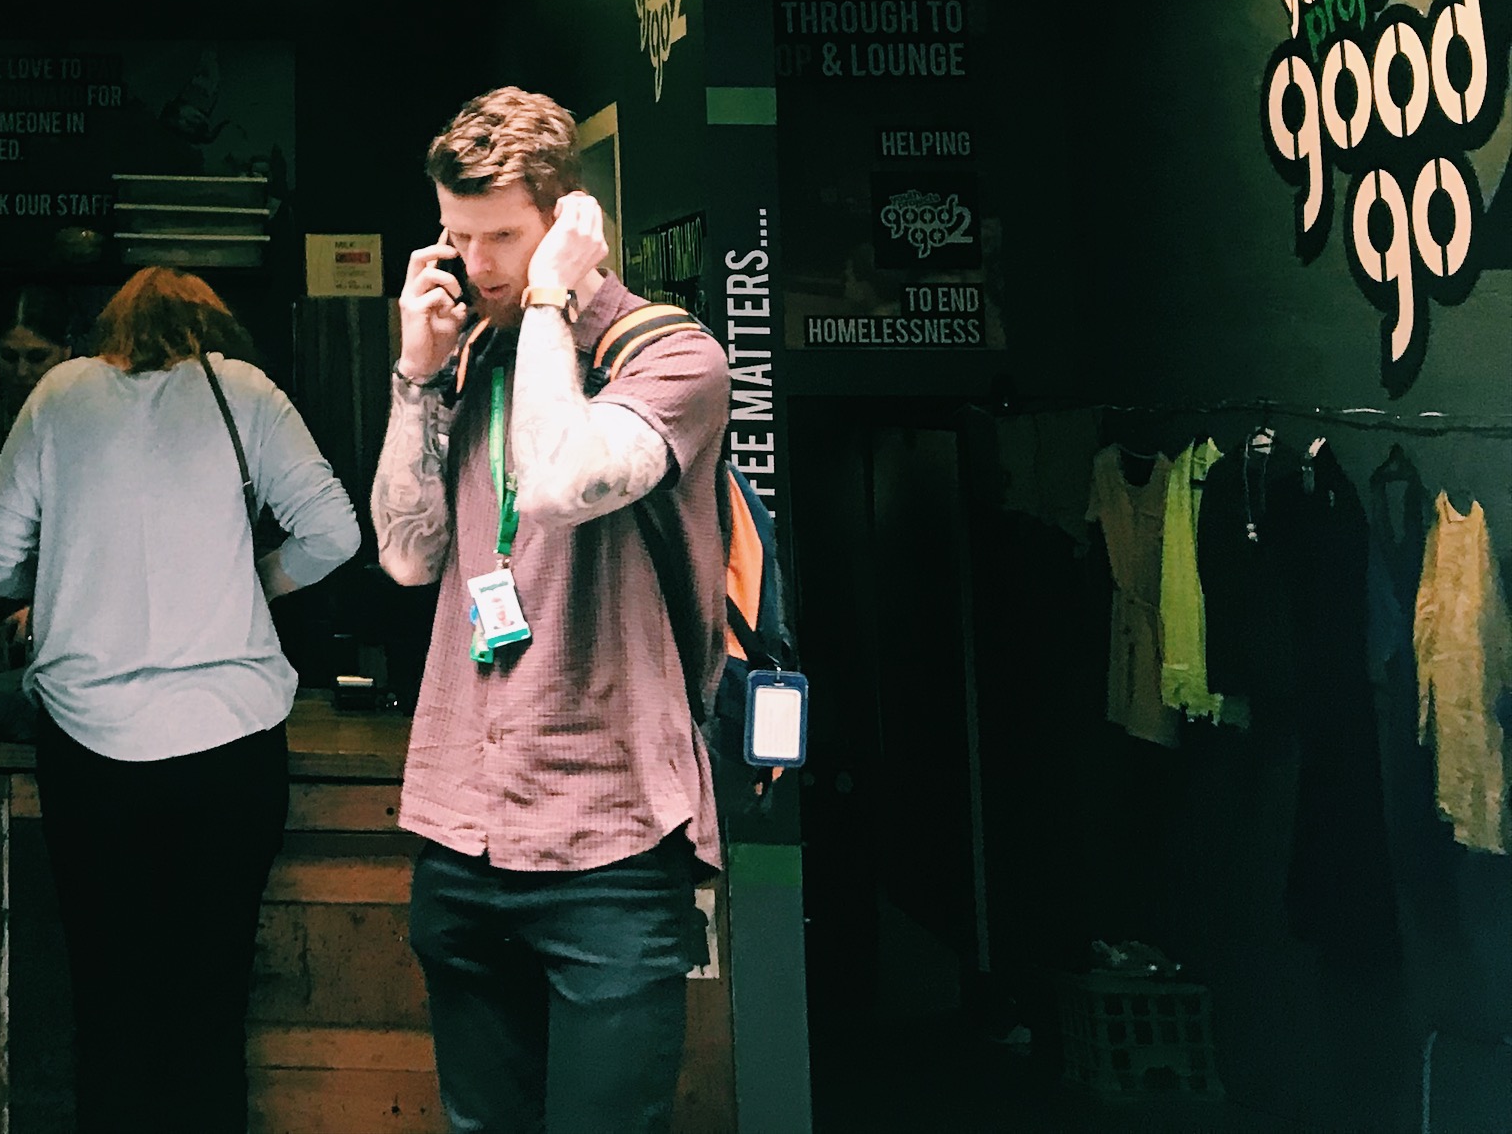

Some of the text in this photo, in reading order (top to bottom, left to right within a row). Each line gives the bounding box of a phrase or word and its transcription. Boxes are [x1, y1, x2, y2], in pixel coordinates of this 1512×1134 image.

[781, 0, 963, 34] THROUGH TO
[7, 58, 55, 79] LOVE
[60, 58, 82, 79] TO
[822, 42, 843, 76] &
[851, 42, 965, 76] LOUNGE
[87, 85, 122, 106] FOR
[66, 112, 85, 134] IN
[882, 131, 971, 156] HELPING
[16, 194, 51, 216] OUR
[881, 194, 958, 238] good
[909, 227, 948, 258] go
[1353, 157, 1472, 362] go
[905, 287, 979, 312] TO END
[808, 318, 981, 344] HOMELESSNESS
